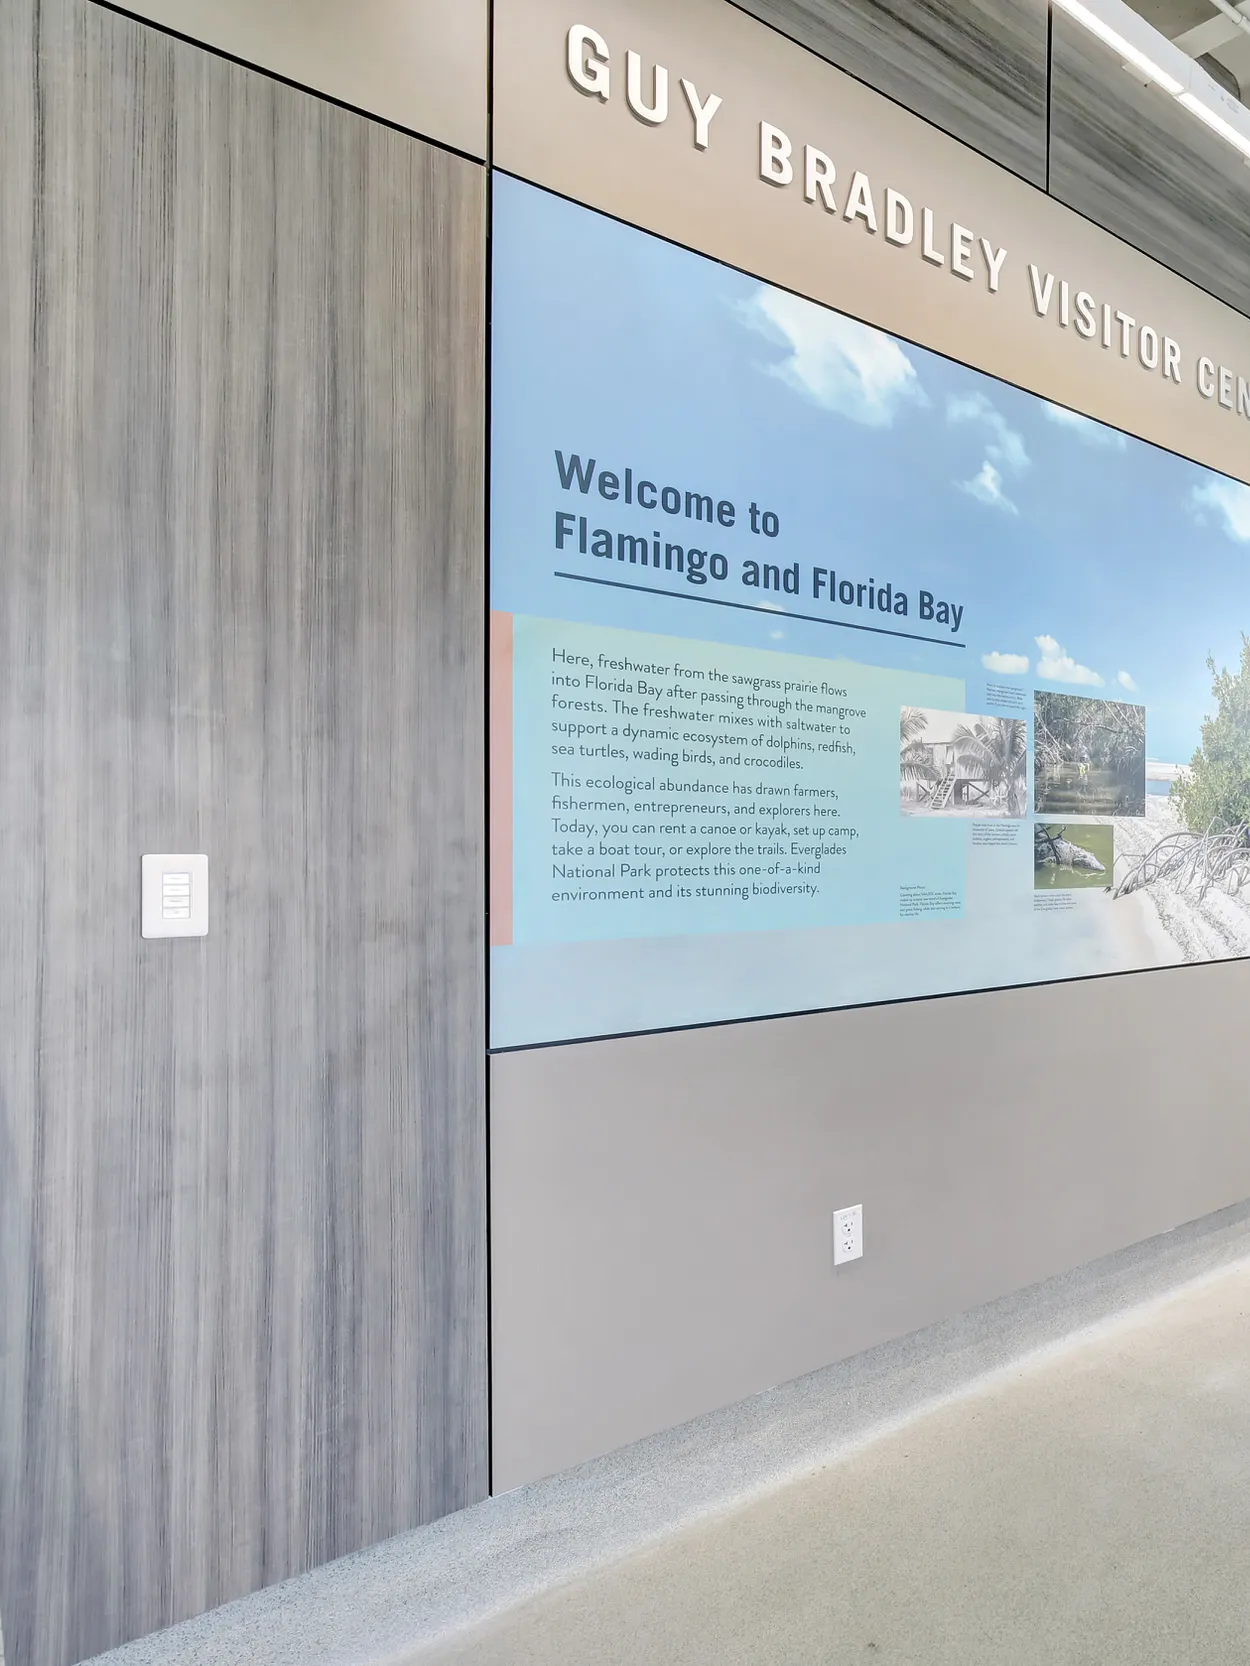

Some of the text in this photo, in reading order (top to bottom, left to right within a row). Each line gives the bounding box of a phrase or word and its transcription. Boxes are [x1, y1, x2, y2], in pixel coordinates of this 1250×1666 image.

[564, 22, 723, 151] GUY
[757, 119, 1008, 294] BRADLEY
[1027, 263, 1184, 385] VISITOR
[554, 450, 779, 538] Welcome to
[555, 511, 964, 633] Flamingo and Florida Bay
[553, 647, 847, 697] Here, freshwater from the sawgrass prairie flows
[552, 671, 866, 720] into Florida Bay after passing through the mangrove
[551, 693, 851, 735] forests. The freshwater mixes with saltwater to
[552, 722, 856, 756] support a dynamic ecosystem of dolphins, redfish,
[552, 743, 803, 769] sea turtles, wading birds, and crocodiles.
[551, 772, 838, 800] This ecological abundance has drawn farmers,
[552, 795, 840, 821] fishermen, entrepreneurs, and explorers here.
[551, 818, 859, 841] Today, you can rent a canoe or kayak, set up camp,
[552, 841, 847, 860] take a boat tour, or explore the trails. Everglades
[553, 861, 820, 882] National Park protects this one-of-a-kind
[552, 881, 819, 901] environment and its stunning biodiversity.
